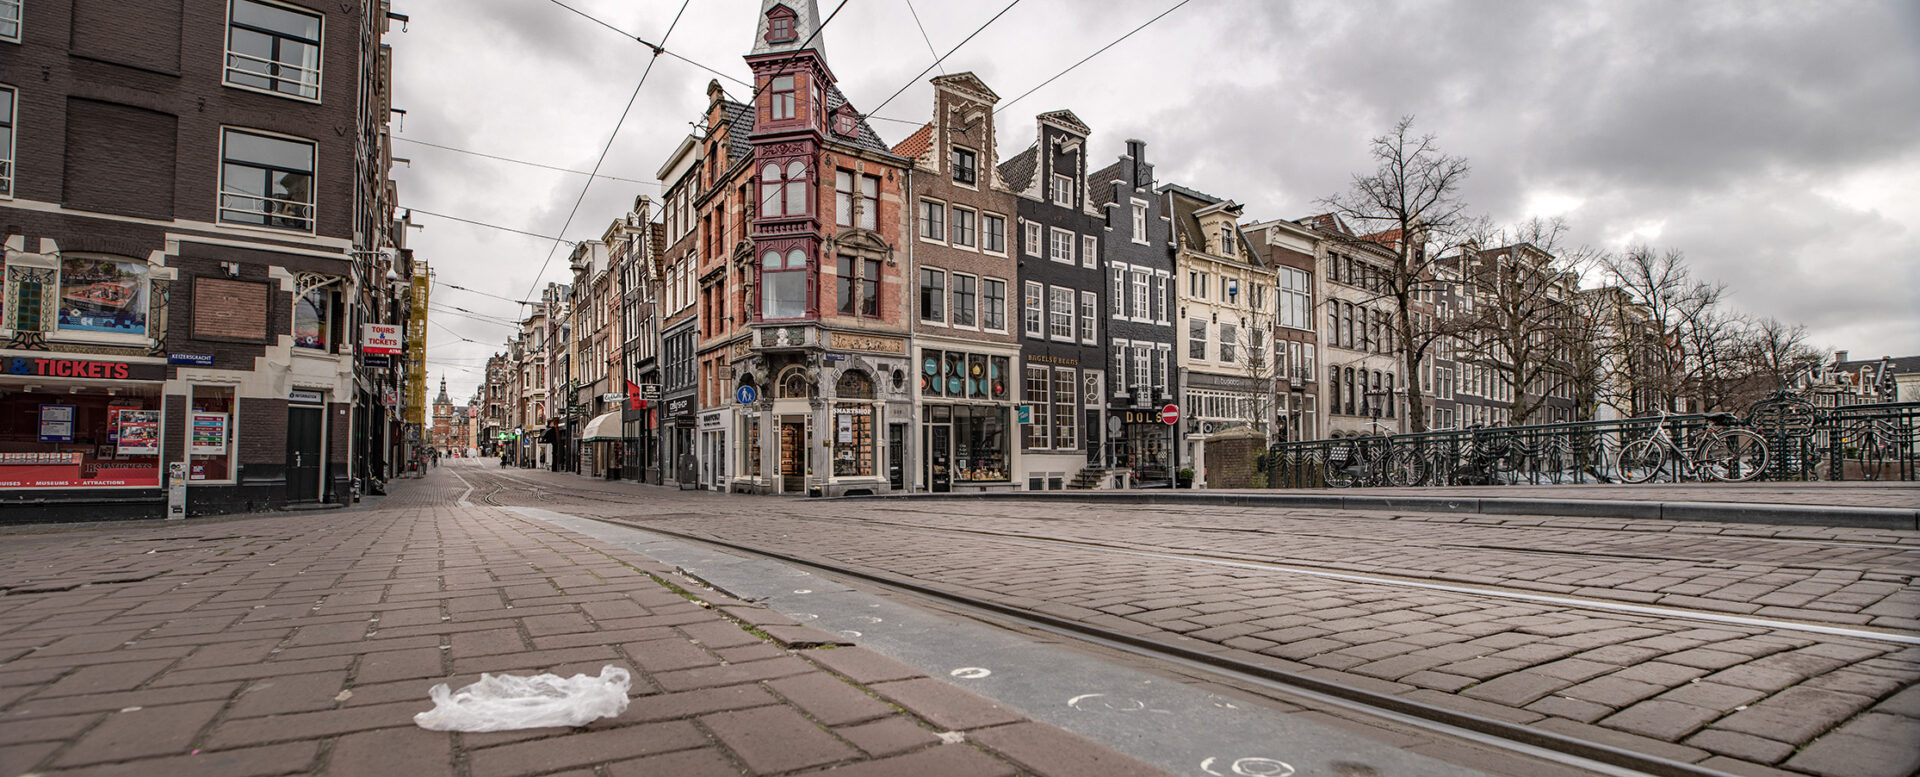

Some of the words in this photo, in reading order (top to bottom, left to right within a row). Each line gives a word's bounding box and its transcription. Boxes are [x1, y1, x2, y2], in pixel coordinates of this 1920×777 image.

[372, 326, 395, 334] TOURS
[368, 337, 398, 346] TICKETS
[10, 357, 29, 375] &
[34, 358, 129, 379] TICKETS
